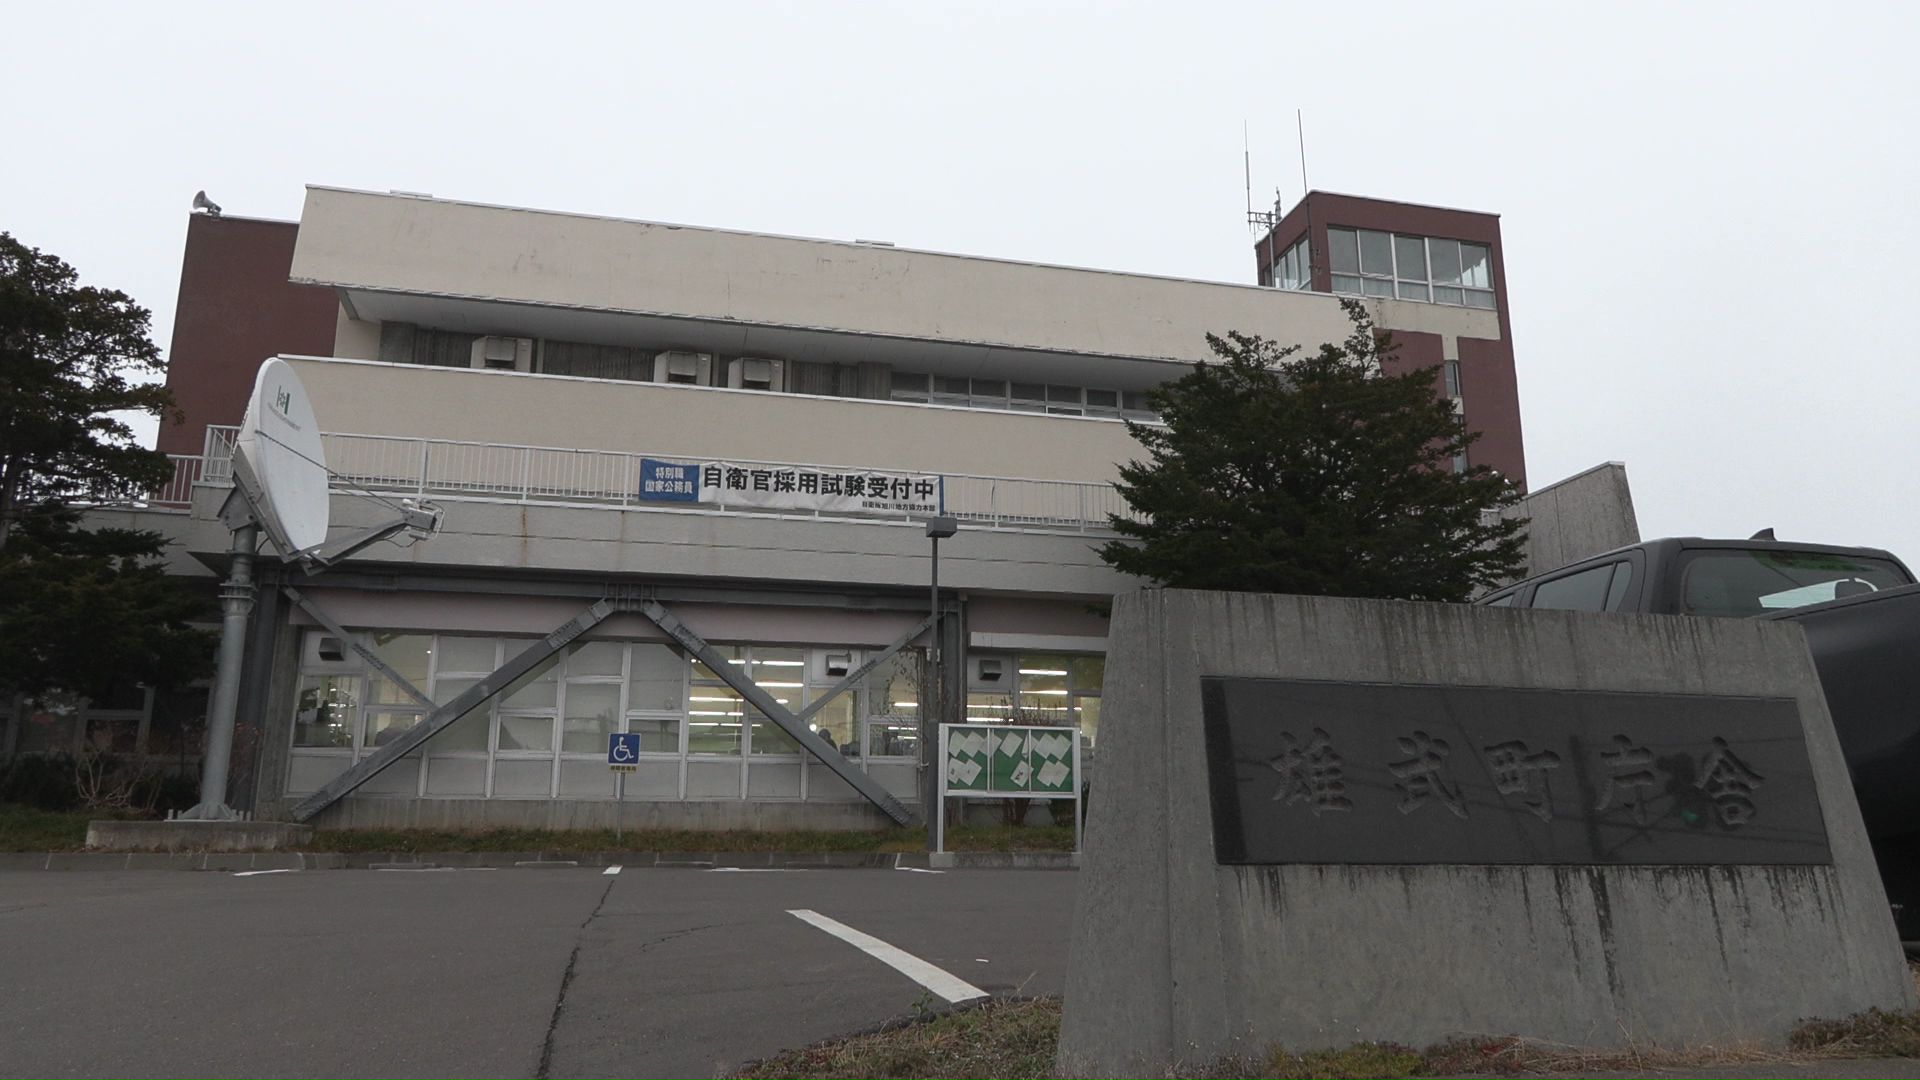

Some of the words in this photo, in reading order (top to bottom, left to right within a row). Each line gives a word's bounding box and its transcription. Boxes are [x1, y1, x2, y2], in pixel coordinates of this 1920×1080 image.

[656, 467, 684, 479] 特別職
[704, 466, 933, 500] 自衛官採用試験受付中
[645, 481, 692, 494] 国家公務員
[1271, 727, 1764, 830] 雄武町庁舎
